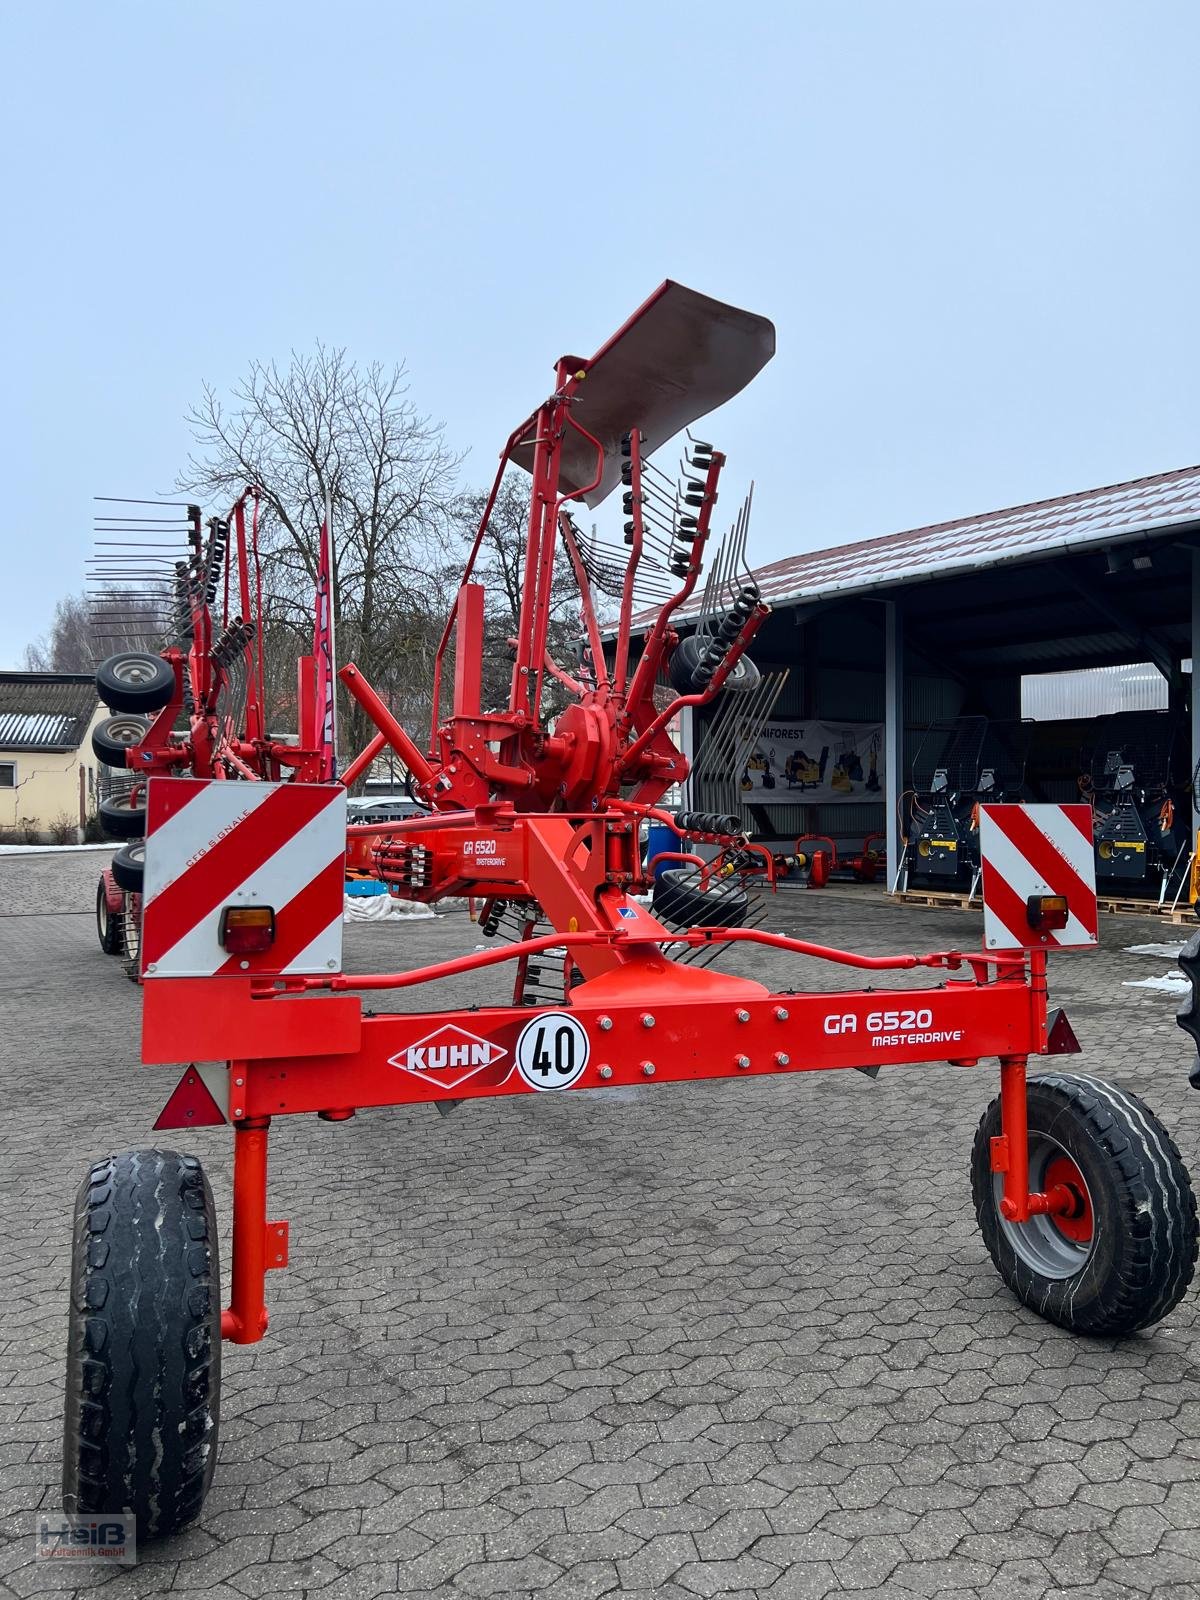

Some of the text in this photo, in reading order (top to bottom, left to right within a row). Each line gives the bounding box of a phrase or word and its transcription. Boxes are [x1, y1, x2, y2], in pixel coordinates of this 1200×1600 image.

[185, 808, 251, 867] CFG SGNALE
[463, 840, 497, 855] GA 6520
[823, 1009, 933, 1034] GA 6520
[531, 1025, 575, 1077] 40
[872, 1030, 962, 1047] MASTERDRIVE
[406, 1043, 491, 1071] KUHN
